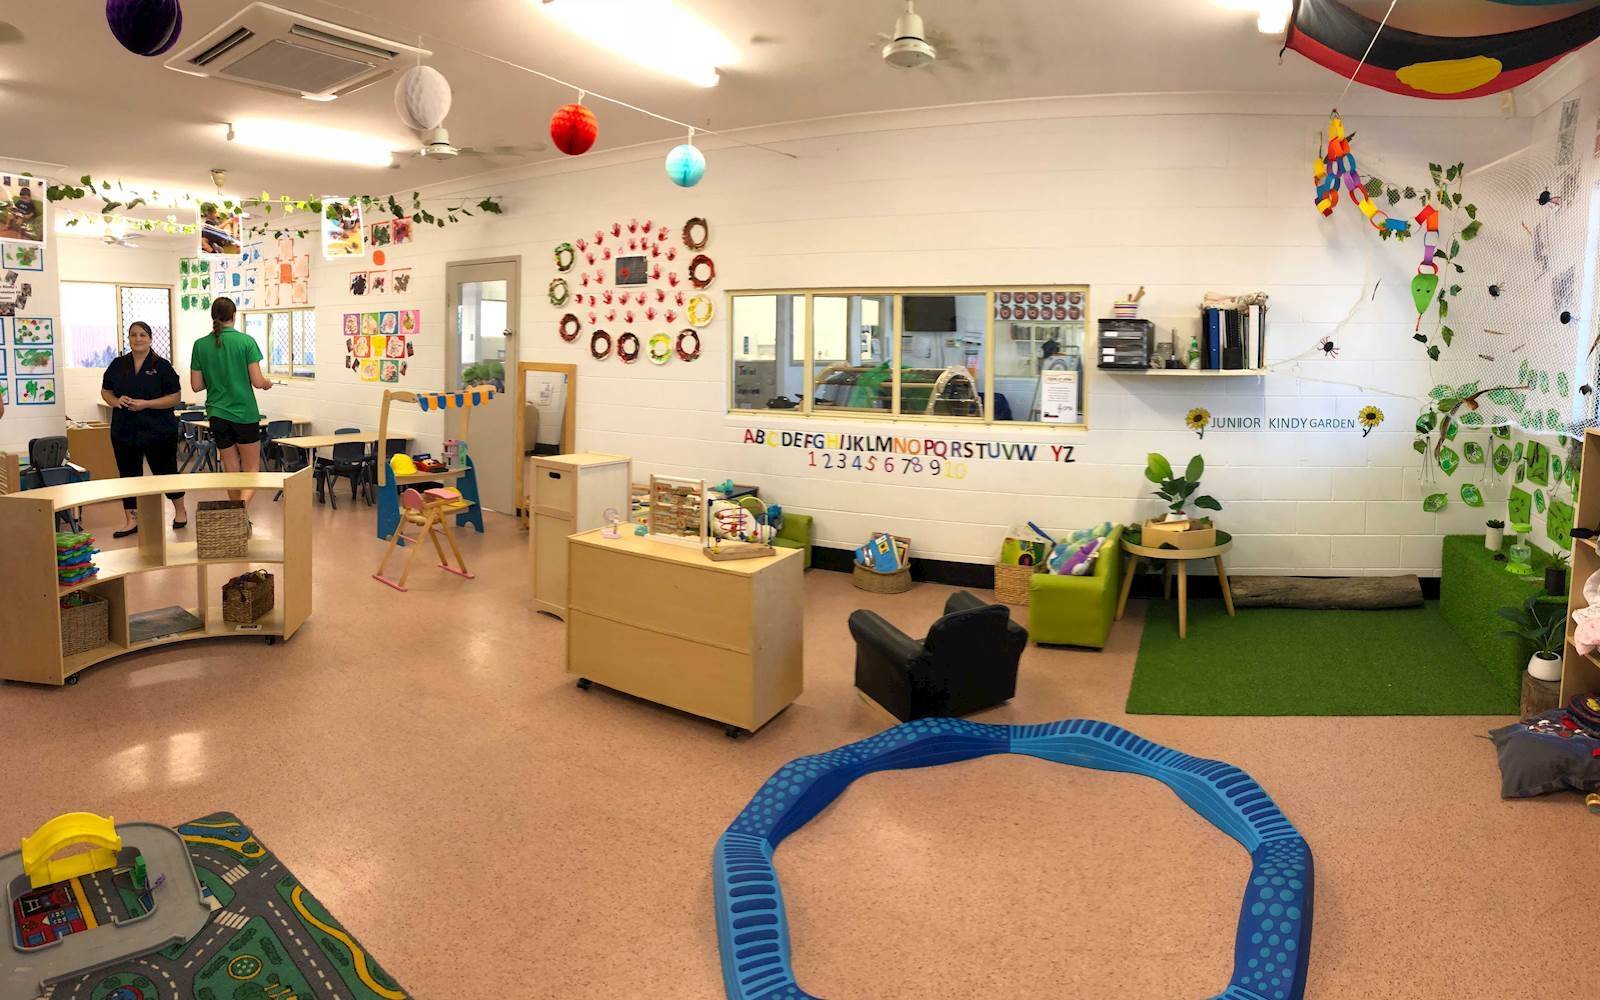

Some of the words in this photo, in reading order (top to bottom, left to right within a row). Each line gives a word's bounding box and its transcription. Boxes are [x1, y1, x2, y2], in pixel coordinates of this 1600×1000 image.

[808, 451, 817, 467] 1
[822, 453, 833, 469] 2
[837, 453, 847, 469] 3
[852, 455, 862, 470] 4
[865, 455, 878, 471] 5
[884, 457, 895, 473] 6
[929, 459, 941, 475] 9
[944, 460, 968, 479] 10
